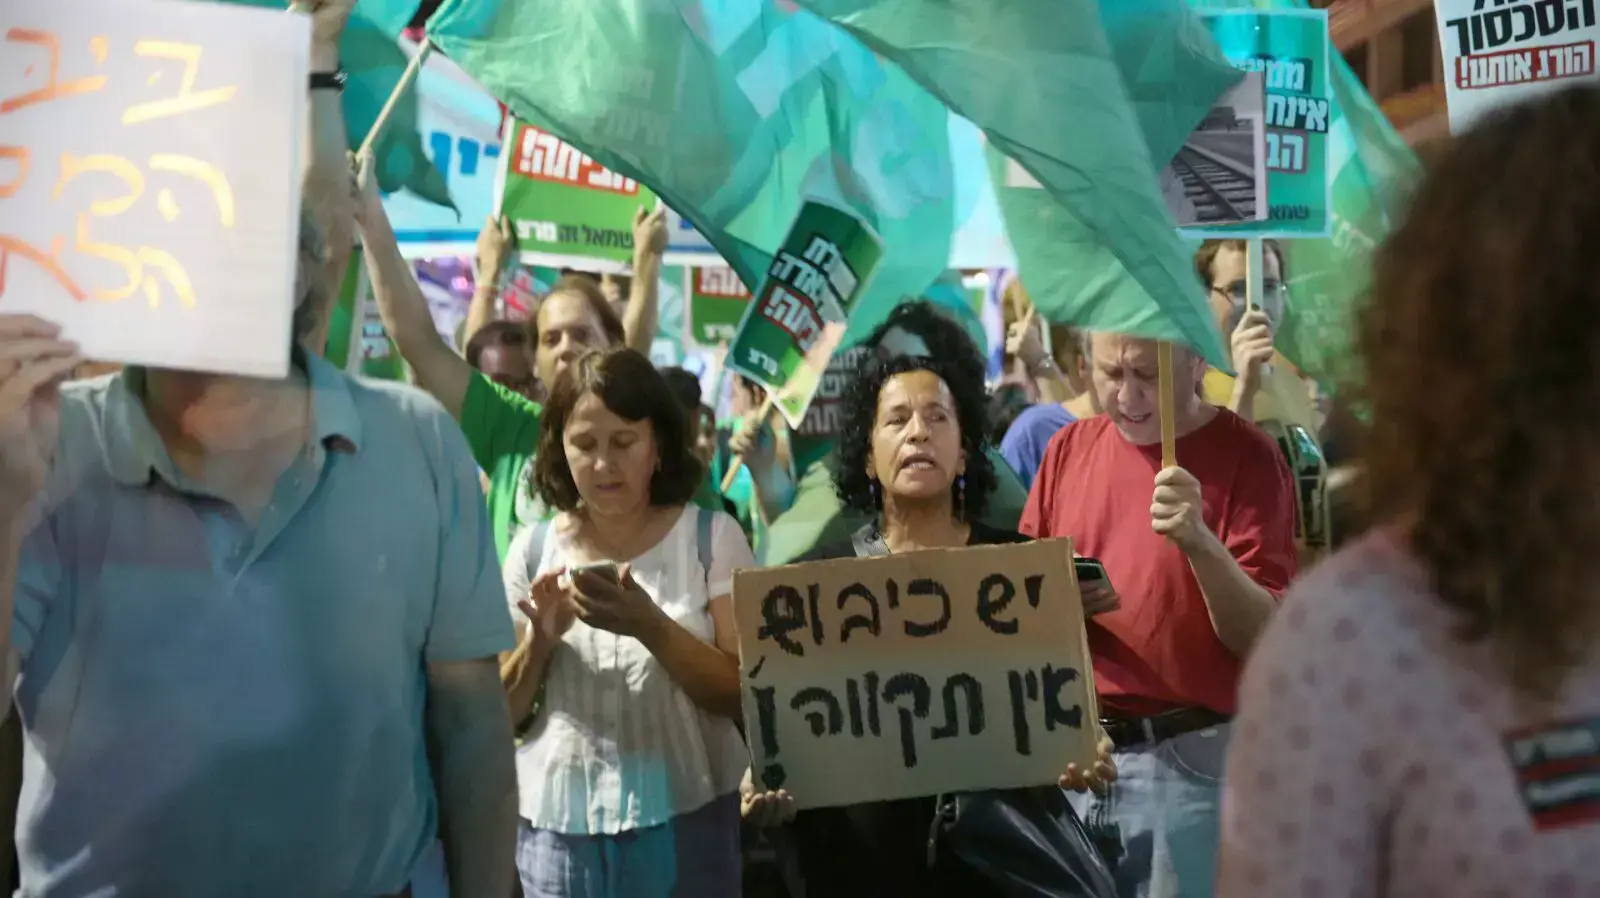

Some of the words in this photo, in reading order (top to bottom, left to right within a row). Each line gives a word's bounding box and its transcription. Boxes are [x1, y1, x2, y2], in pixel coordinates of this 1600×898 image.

[1446, 0, 1596, 56] הסכסוך
[1460, 50, 1533, 88] אותנו!
[1536, 44, 1591, 78] הורג
[559, 225, 578, 243] זה
[976, 573, 1045, 634] יש
[1007, 662, 1083, 756] אין
